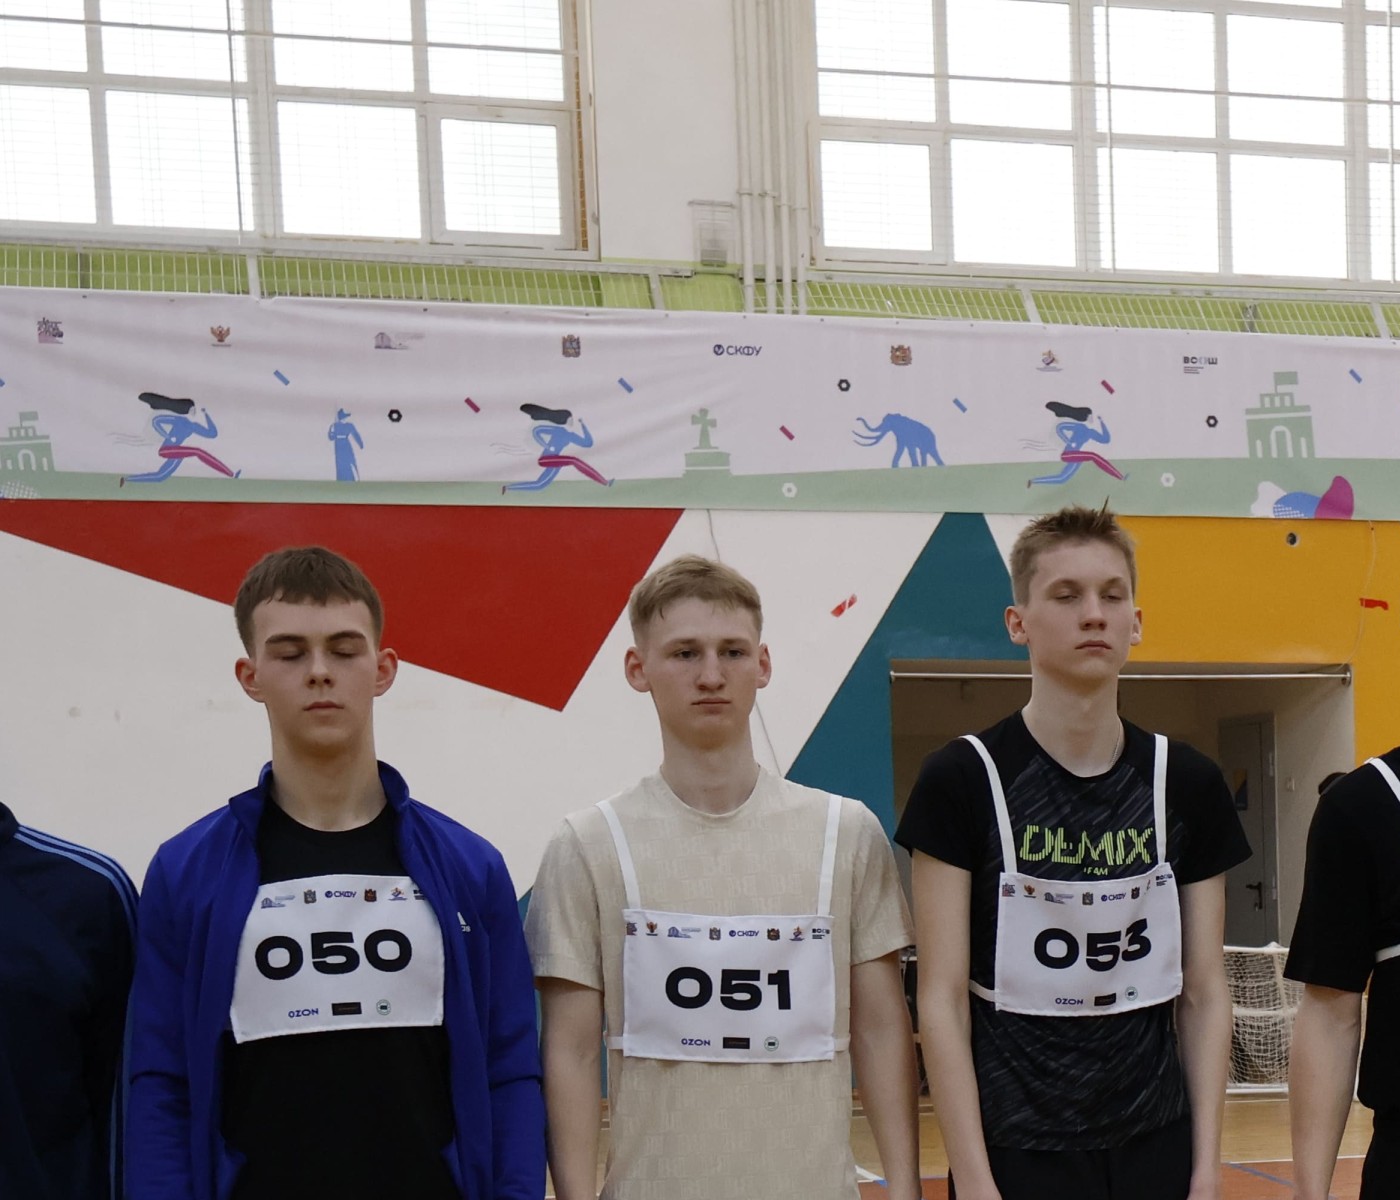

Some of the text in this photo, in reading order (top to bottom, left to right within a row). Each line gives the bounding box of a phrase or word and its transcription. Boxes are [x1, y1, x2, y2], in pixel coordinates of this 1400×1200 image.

[726, 345, 763, 356] СКФУ
[1034, 918, 1152, 972] 053
[255, 929, 412, 980] 050
[665, 966, 791, 1011] 051
[1055, 997, 1084, 1005] OZON
[288, 1008, 319, 1018] OZON
[681, 1038, 711, 1046] OZON
